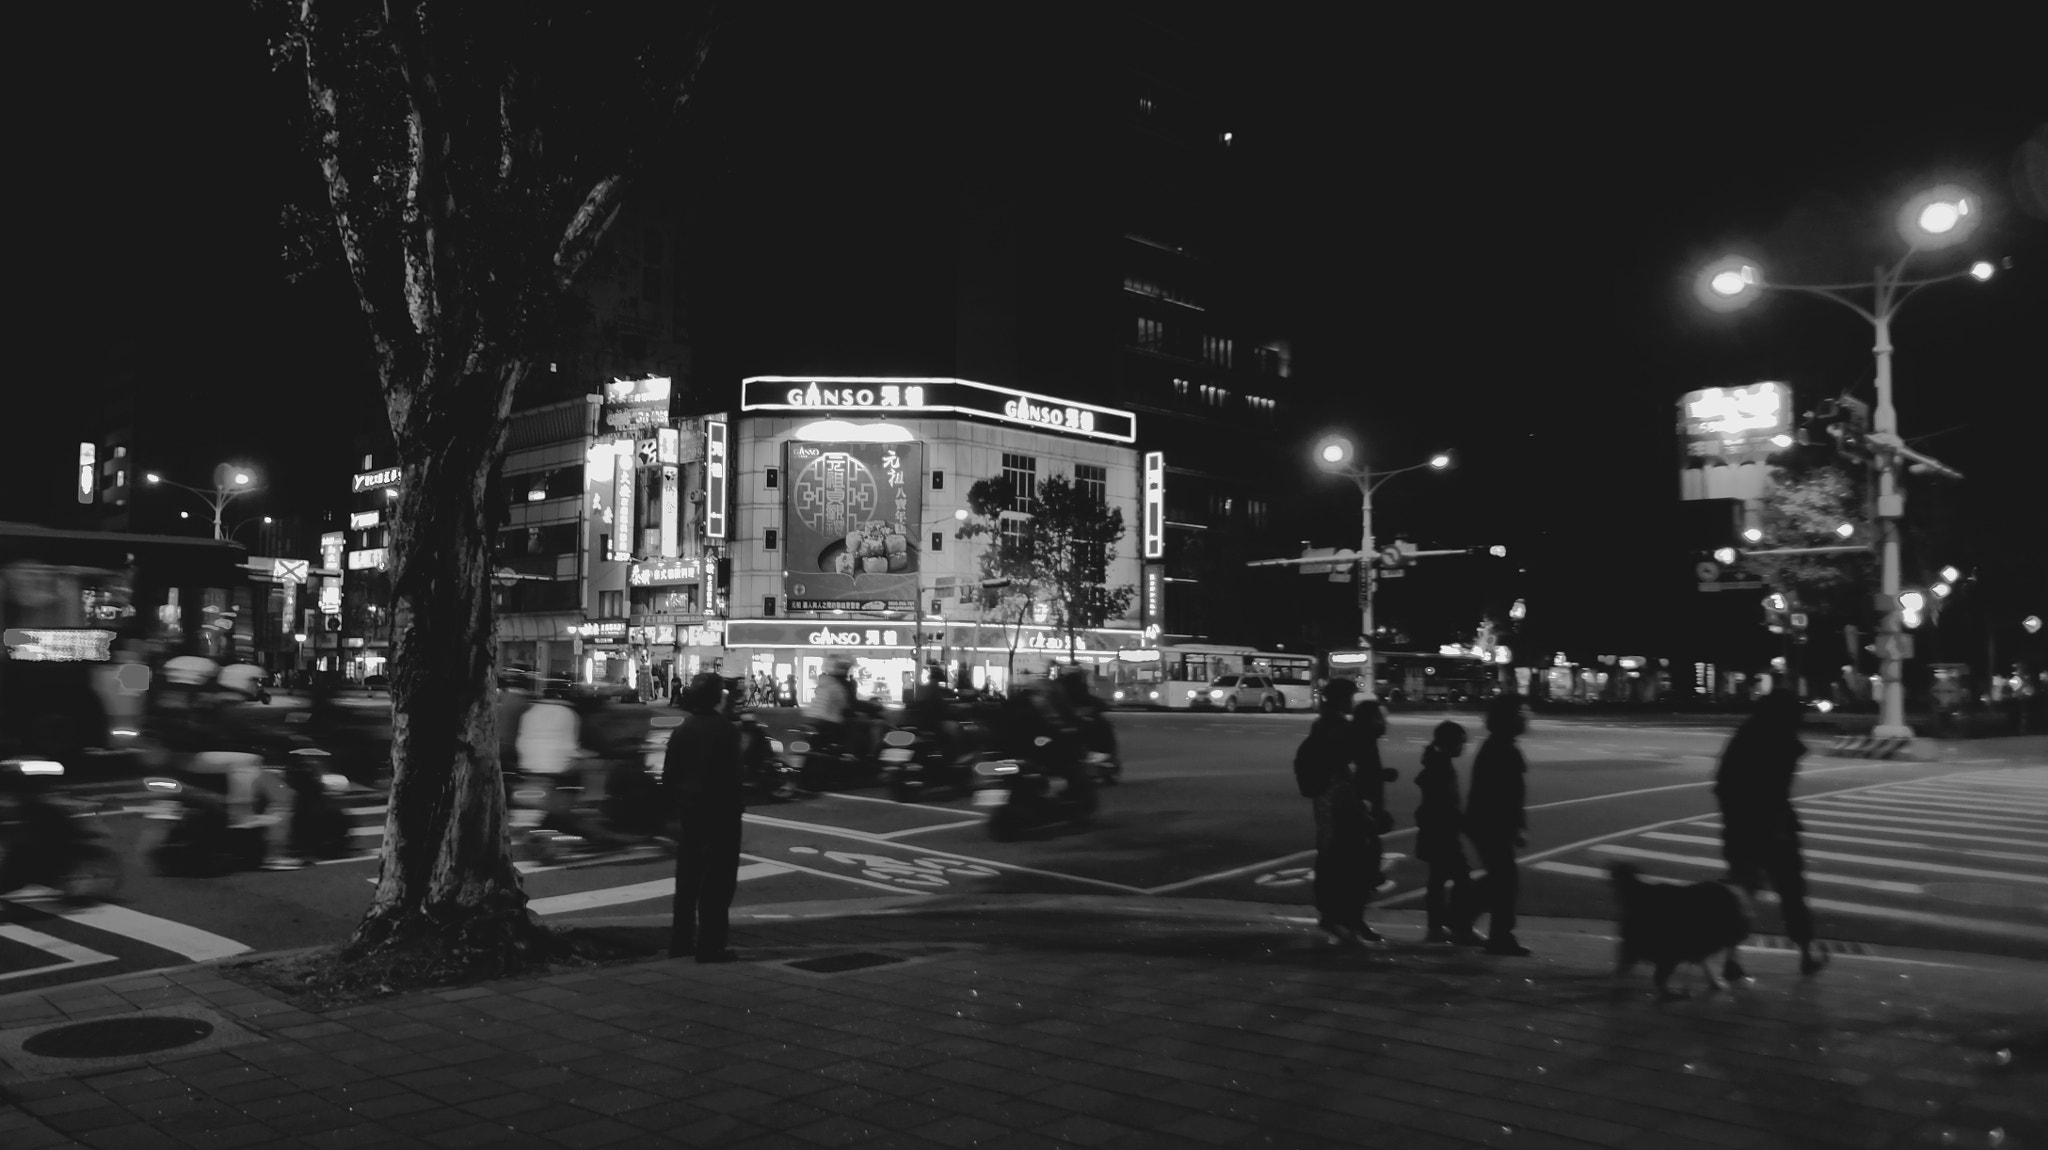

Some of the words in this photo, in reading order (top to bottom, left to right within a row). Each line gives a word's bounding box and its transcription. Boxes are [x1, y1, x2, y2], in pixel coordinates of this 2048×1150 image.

[787, 381, 874, 406] GANSO
[1005, 396, 1064, 426] GANSO
[881, 450, 906, 488] 元祖
[809, 626, 861, 645] GANSO
